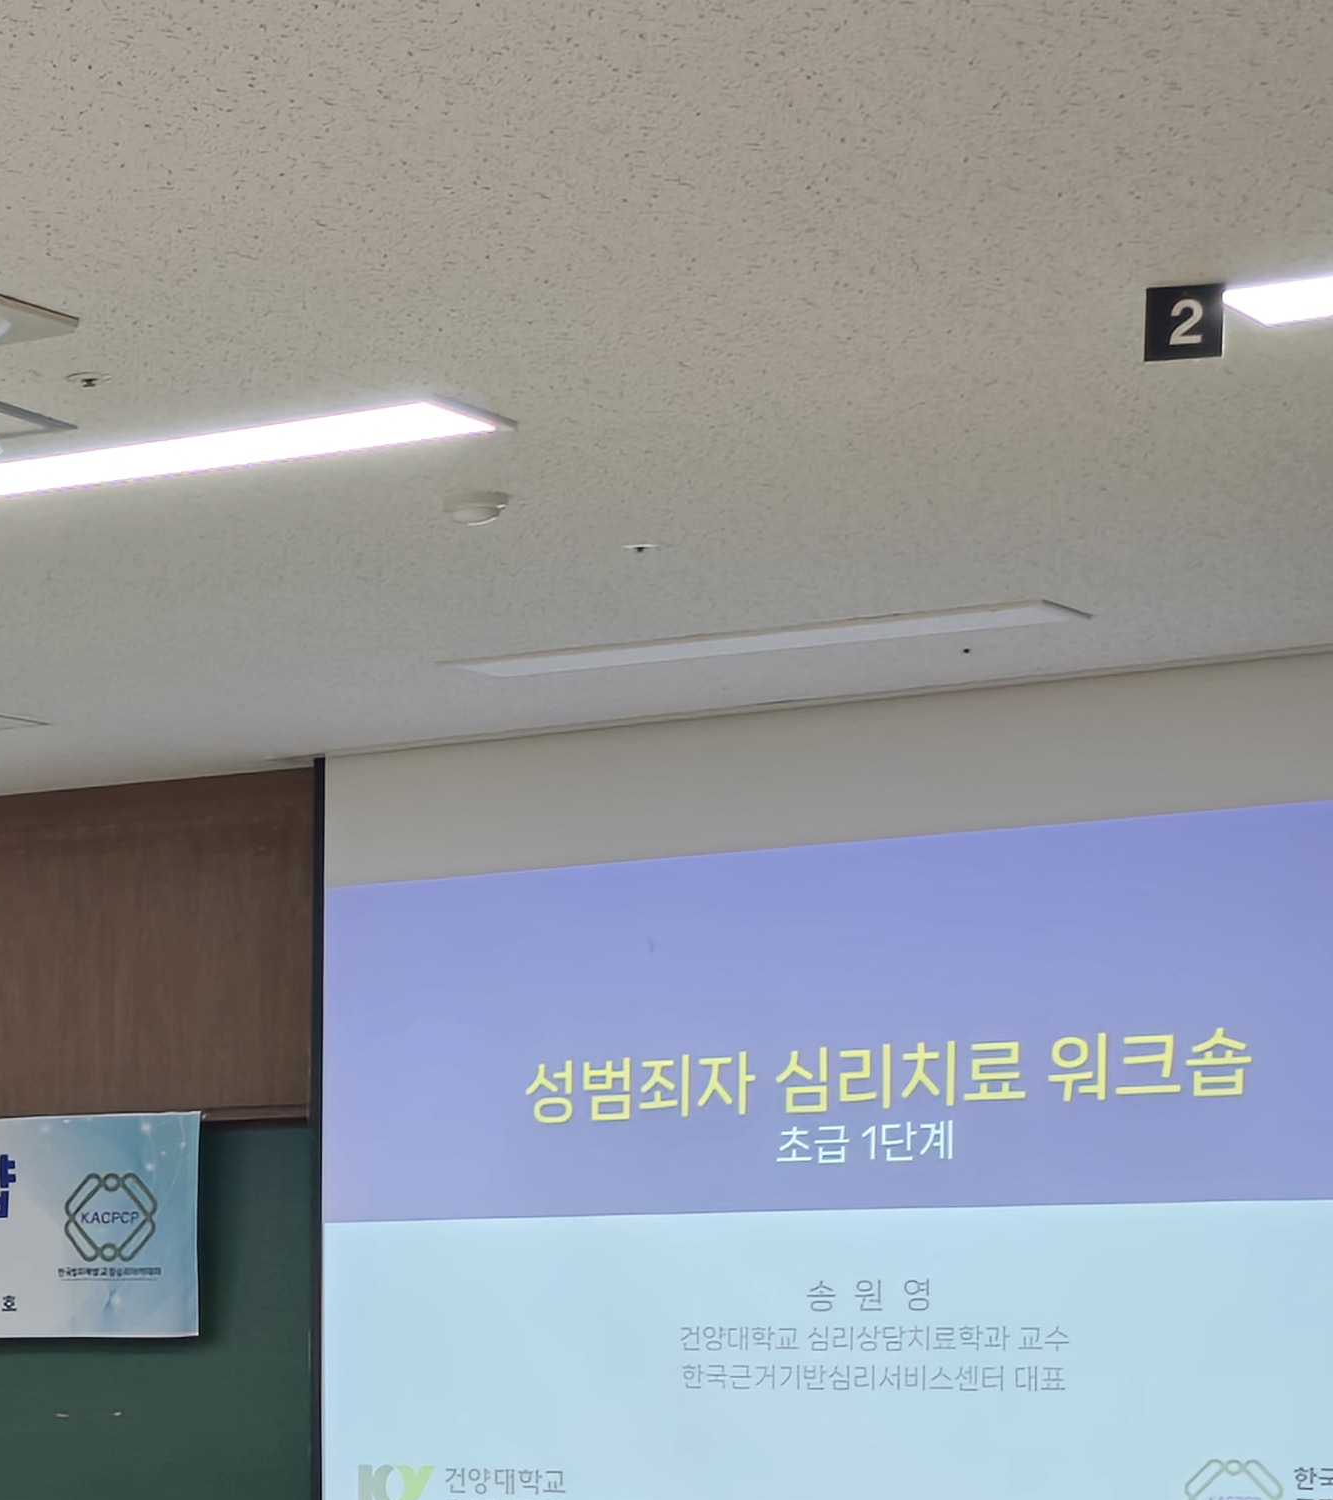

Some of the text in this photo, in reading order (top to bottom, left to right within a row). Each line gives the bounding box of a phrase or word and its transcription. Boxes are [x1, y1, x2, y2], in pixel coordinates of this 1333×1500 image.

[1169, 298, 1204, 346] 2
[525, 1027, 1254, 1125] 성범죄자 심리치료 워크숍
[775, 1119, 954, 1164] 초급 1단계
[79, 1210, 141, 1226] KACPCP
[806, 1278, 930, 1313] 송 원 영
[680, 1324, 1071, 1352] 건양대학교 심리상담치료학과 교수
[681, 1364, 1066, 1392] 한국근거기반심리서비스센터 대표
[445, 1467, 567, 1496] 건양대학교
